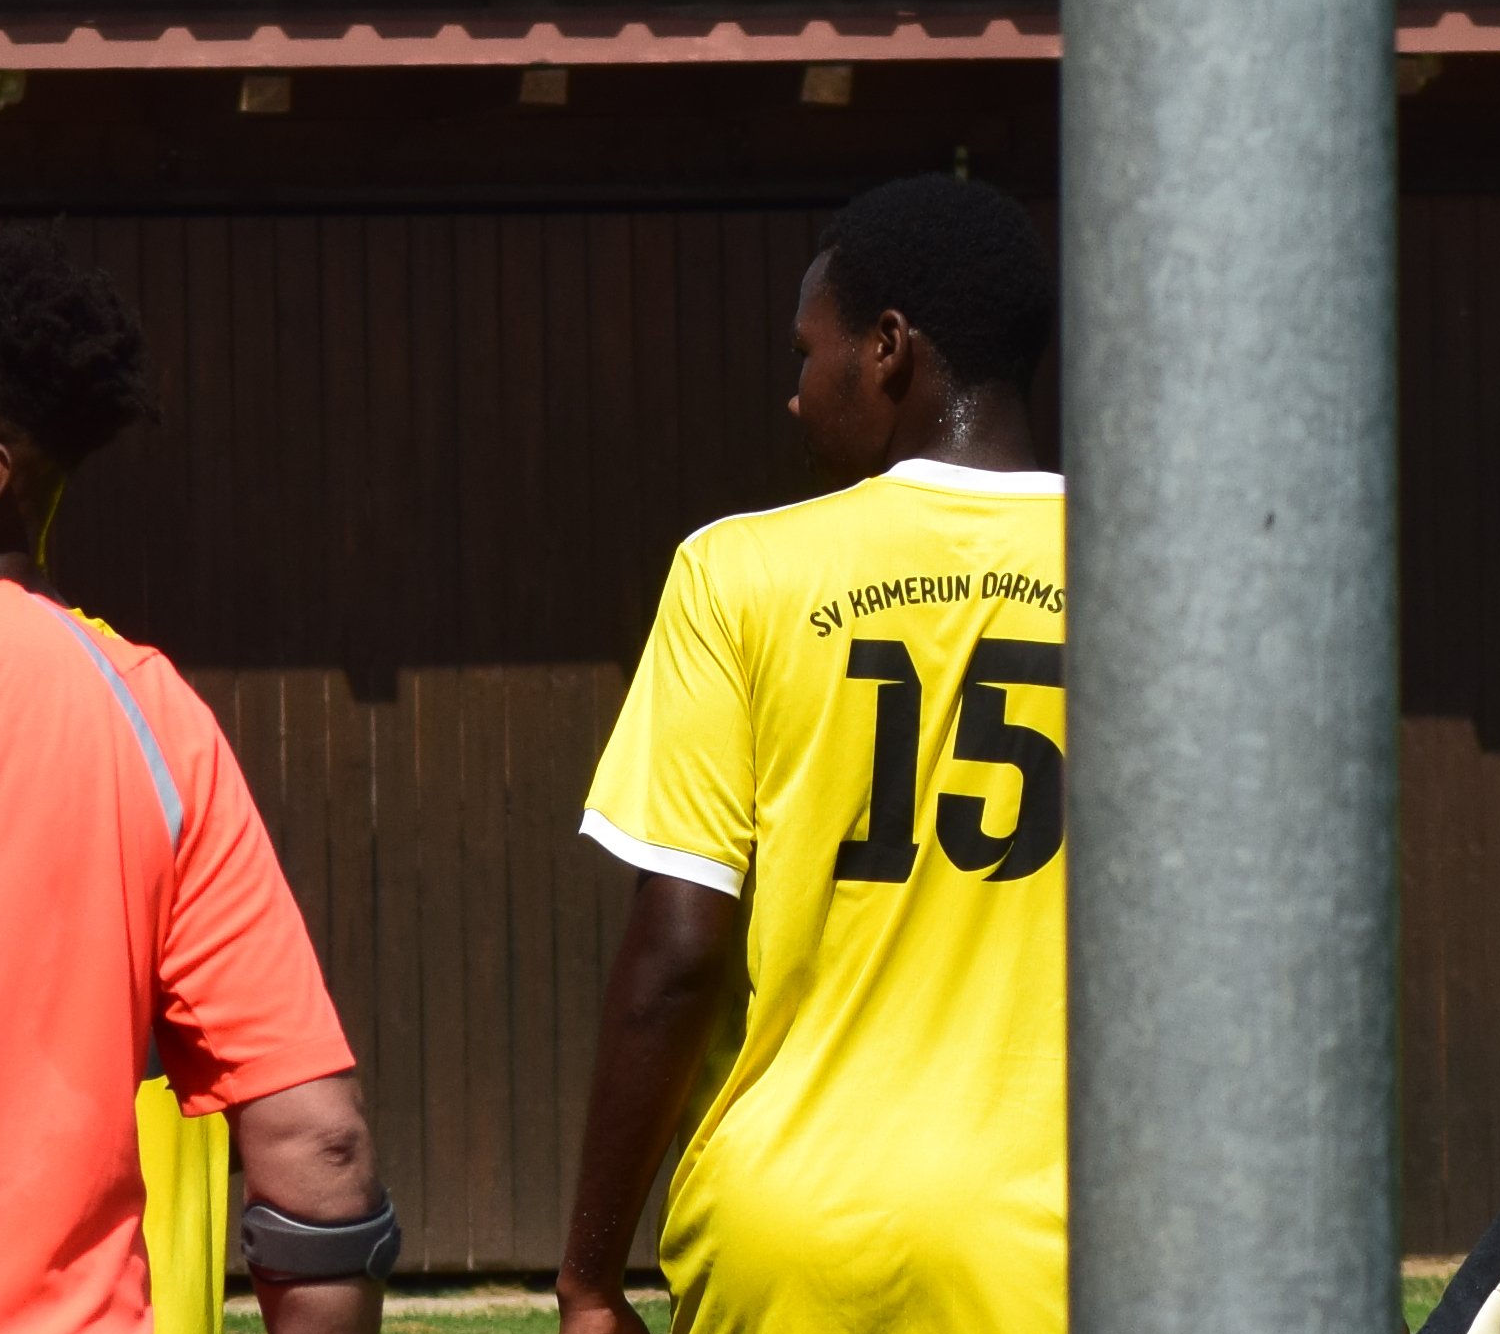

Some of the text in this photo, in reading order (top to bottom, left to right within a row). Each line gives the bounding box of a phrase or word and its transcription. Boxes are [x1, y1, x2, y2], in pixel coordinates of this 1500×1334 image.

[810, 572, 1066, 637] SV KAMERUN DARMS
[833, 638, 1065, 884] 15
